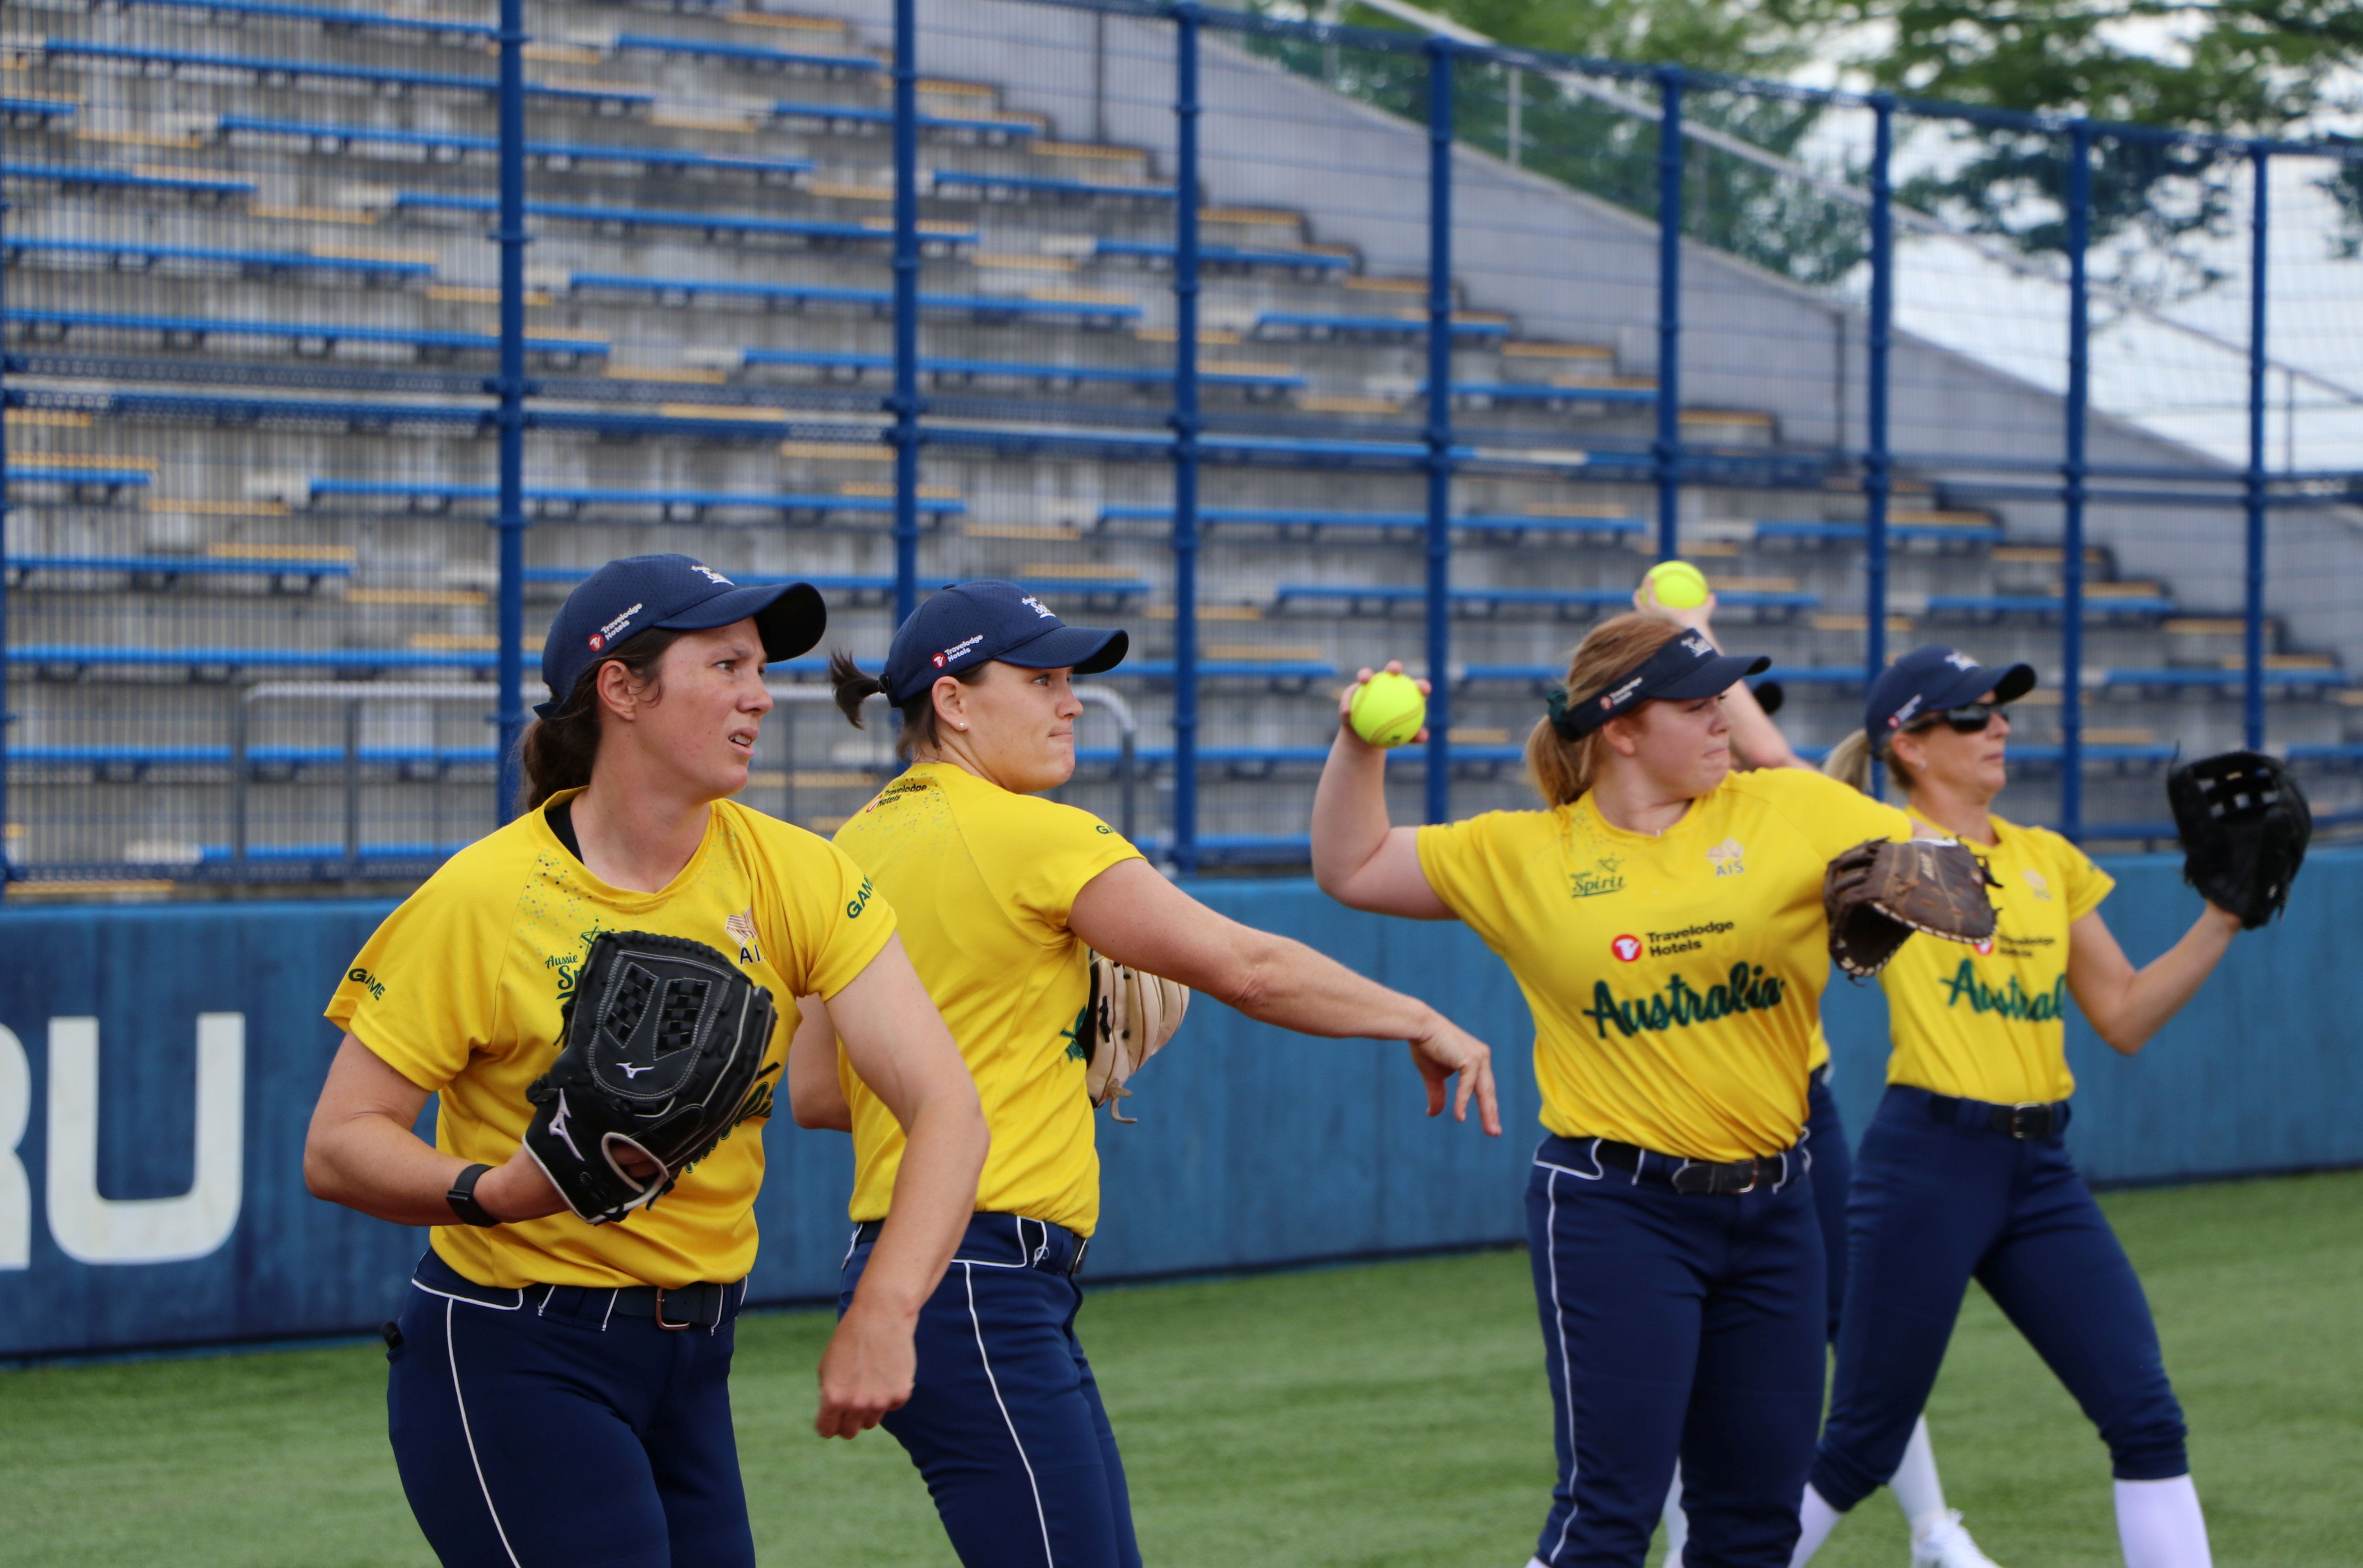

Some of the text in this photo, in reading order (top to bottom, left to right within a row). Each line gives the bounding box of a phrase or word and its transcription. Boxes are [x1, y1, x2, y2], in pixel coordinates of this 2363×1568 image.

[600, 603, 643, 634] Travelodge
[605, 619, 630, 641] Hotels
[944, 634, 983, 656] Travelodge
[947, 647, 971, 662] Hotels
[1715, 859, 1745, 878] AIS
[1573, 876, 1623, 896] Spirit
[1646, 921, 1734, 943] Travelodge
[1650, 940, 1702, 957] Hotels
[545, 952, 578, 969] Aussie
[348, 968, 386, 1001] GAME
[1582, 961, 1786, 1039] Australia
